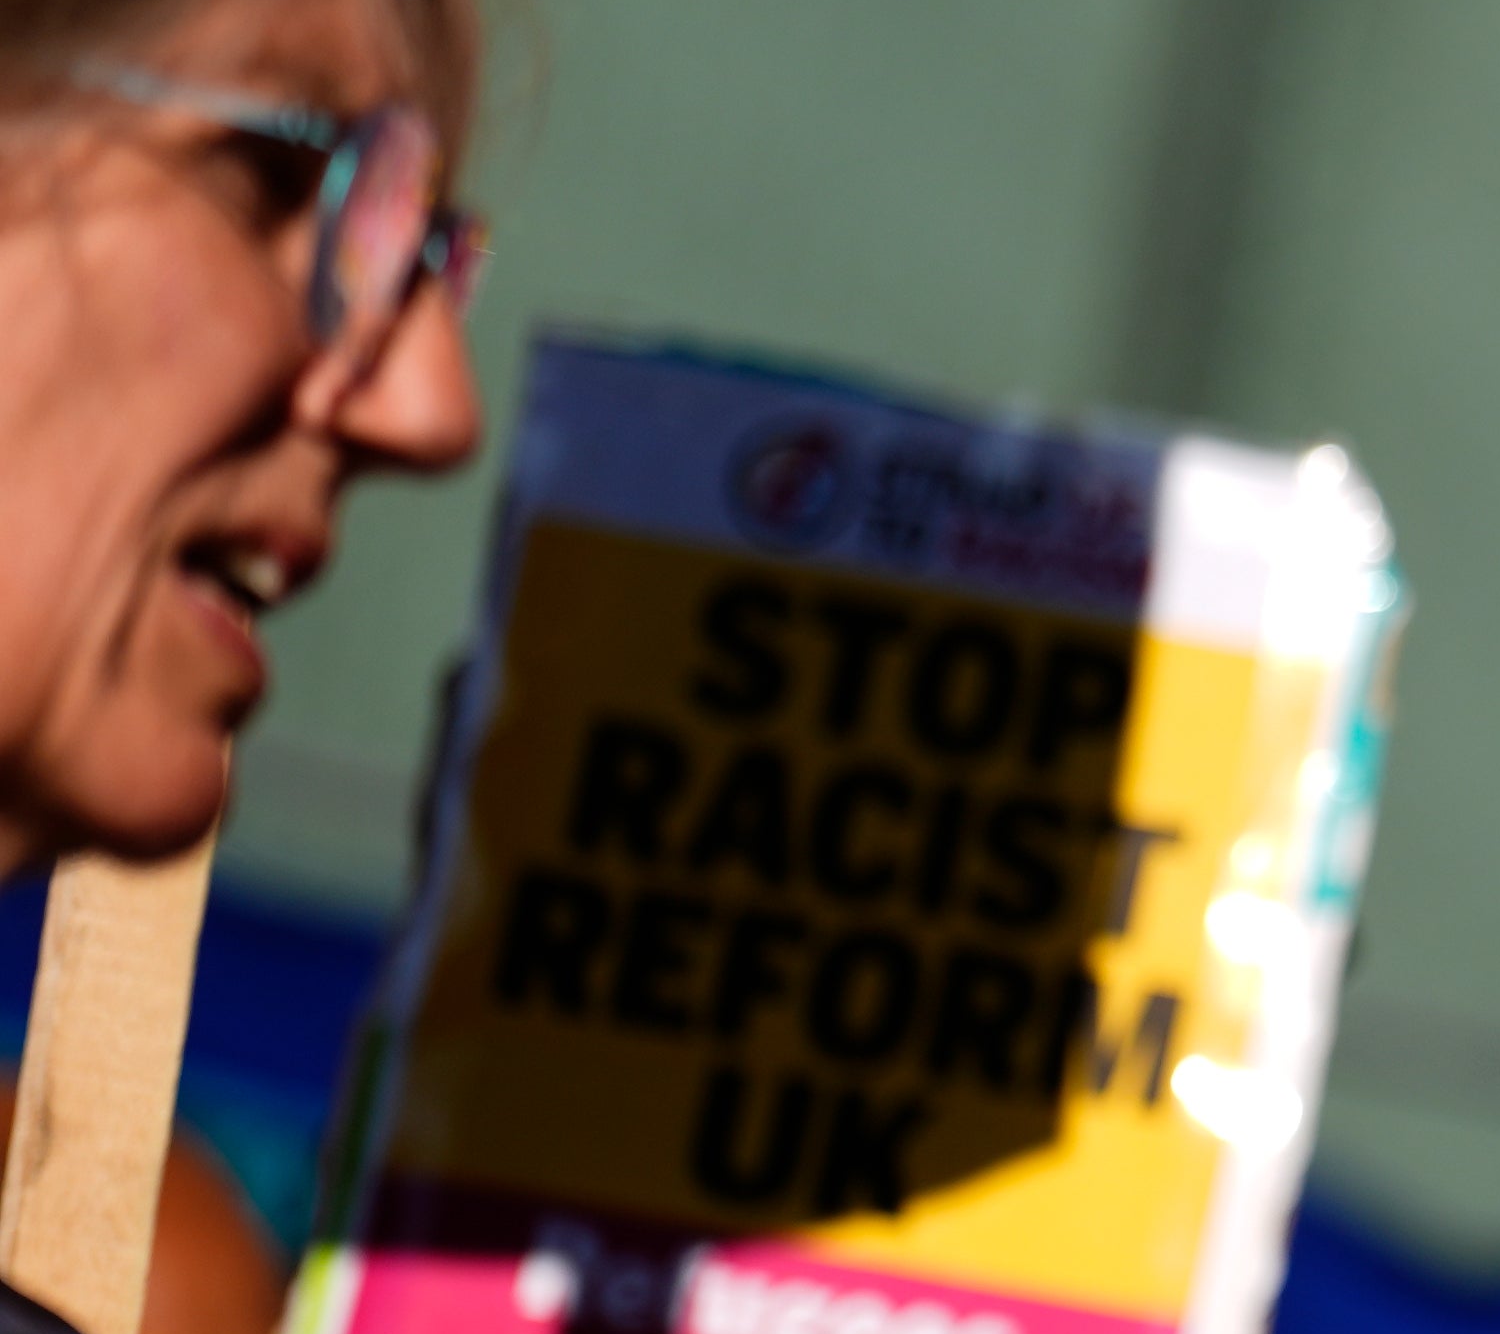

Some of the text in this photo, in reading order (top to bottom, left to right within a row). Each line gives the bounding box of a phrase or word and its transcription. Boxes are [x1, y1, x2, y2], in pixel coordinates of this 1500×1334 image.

[691, 567, 1138, 771] STOP
[568, 713, 1182, 937] RACIST
[492, 867, 1184, 1113] REFORM
[690, 1067, 927, 1222] UK
